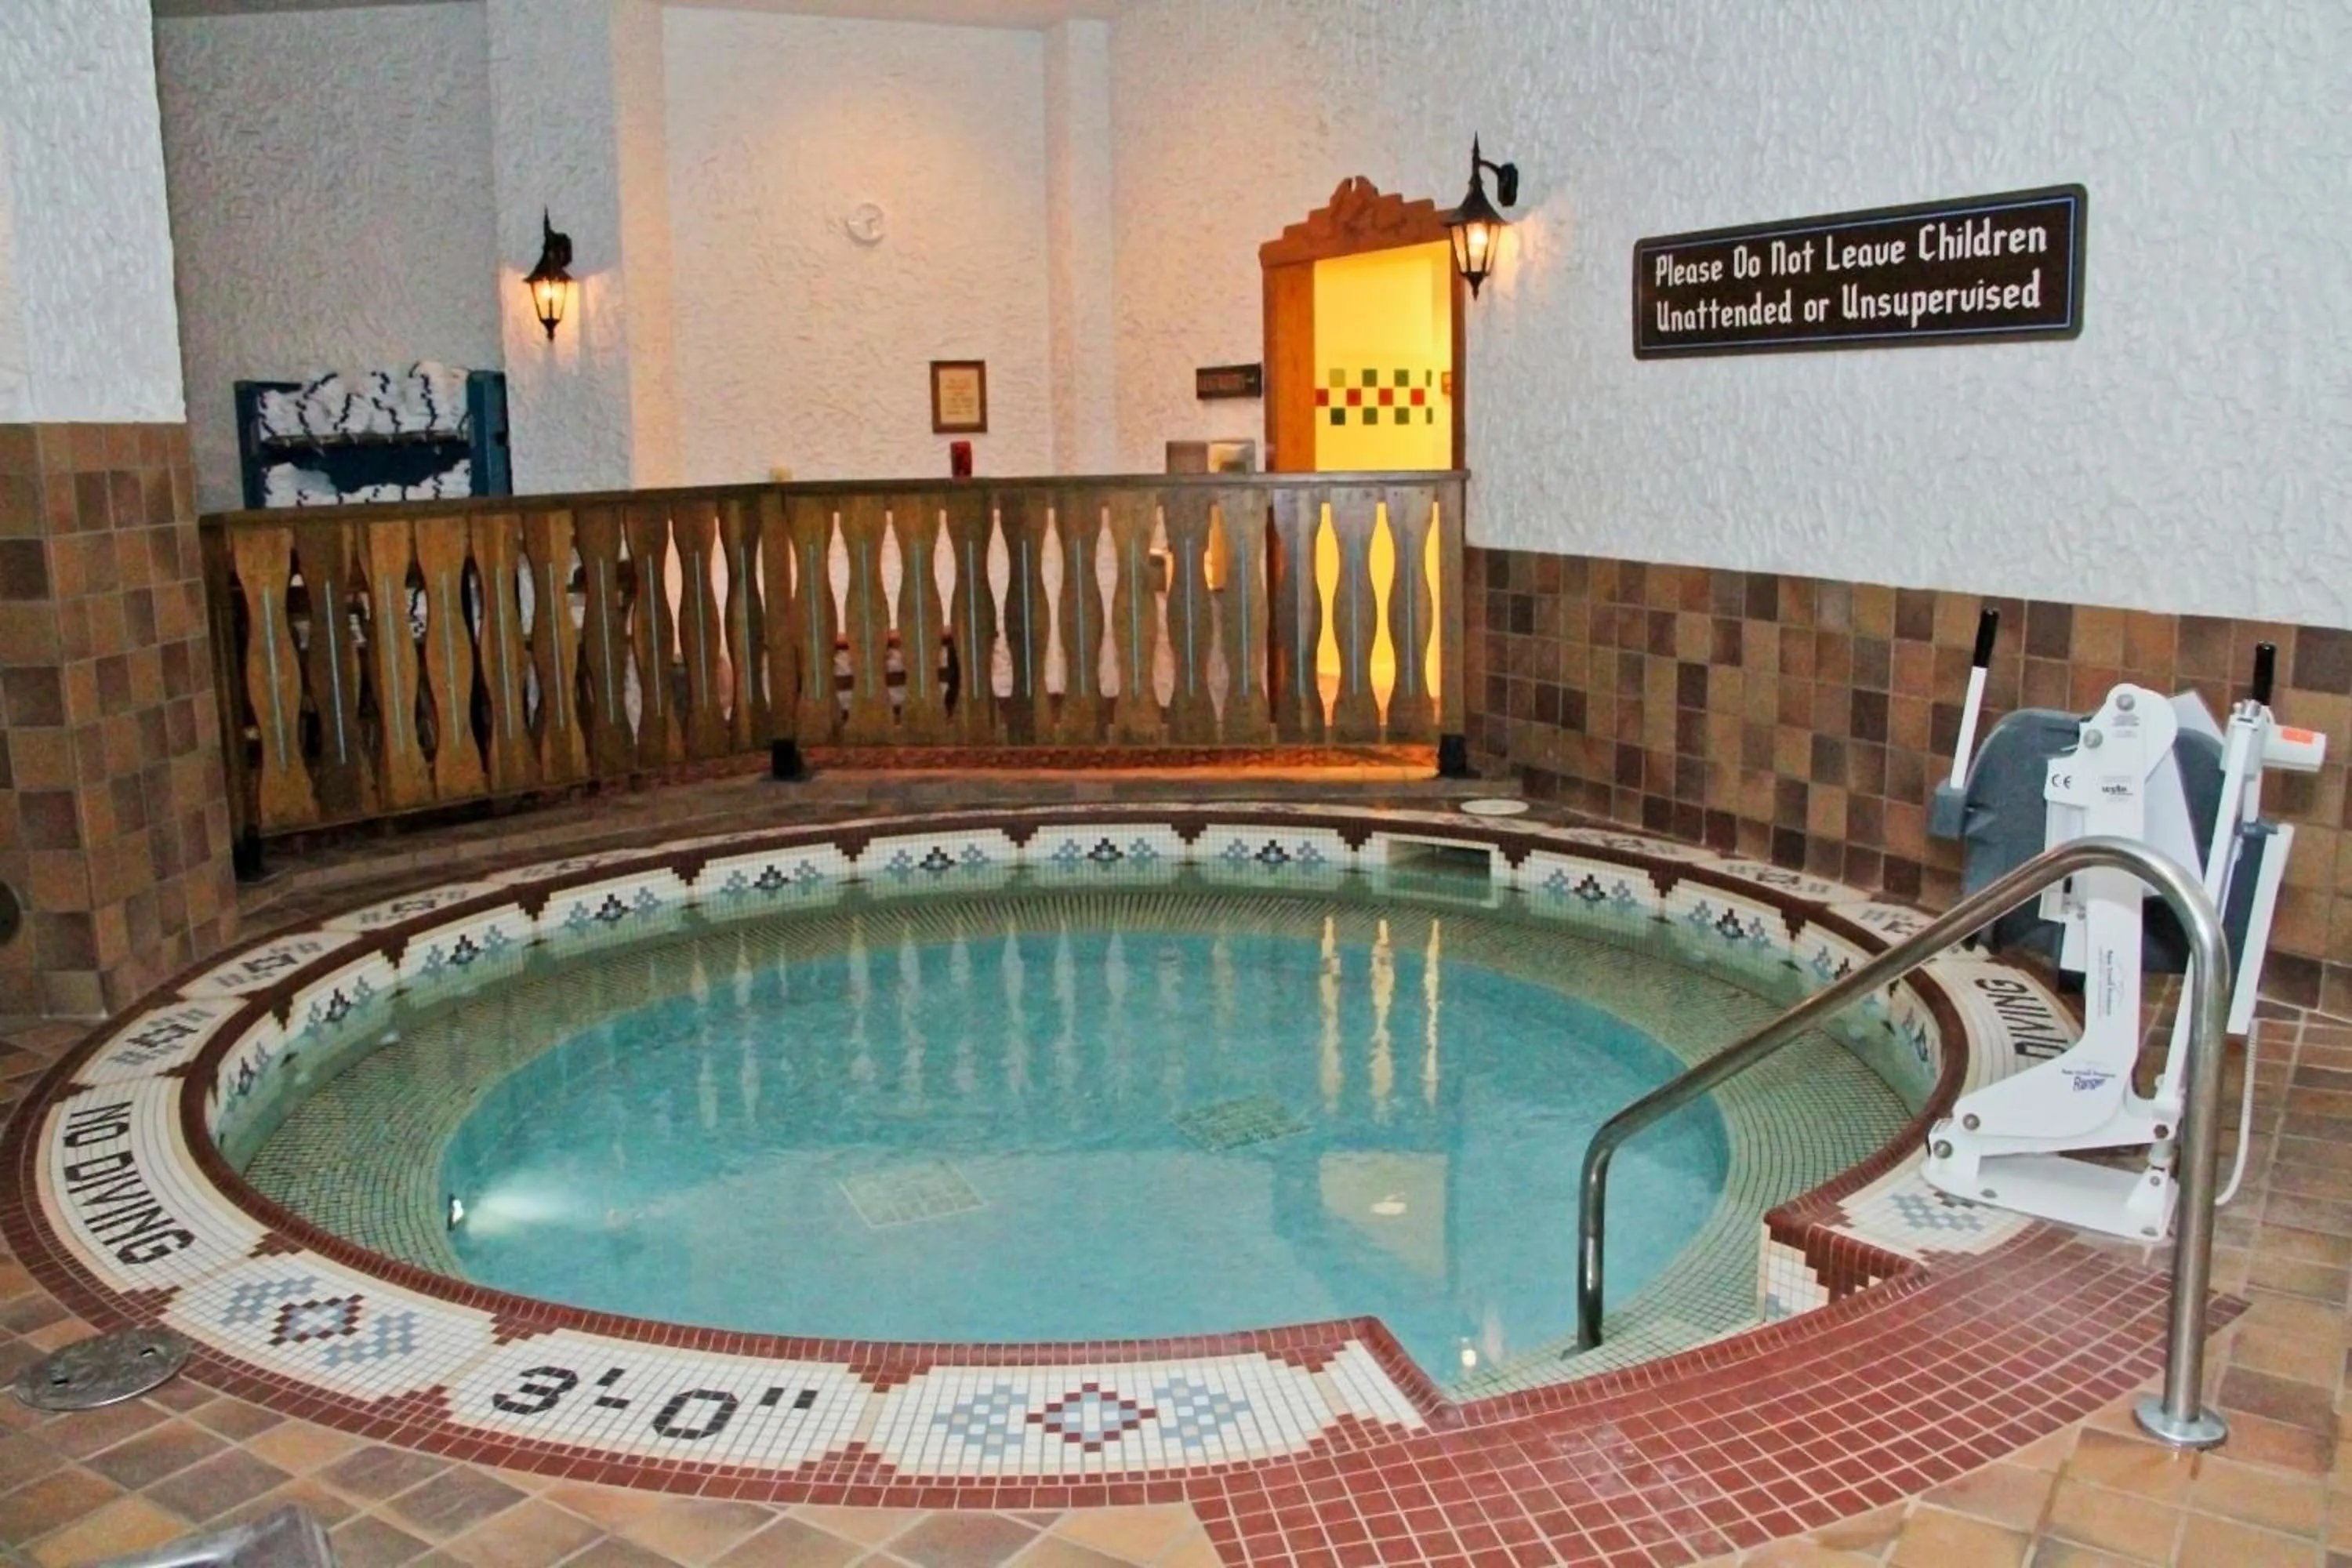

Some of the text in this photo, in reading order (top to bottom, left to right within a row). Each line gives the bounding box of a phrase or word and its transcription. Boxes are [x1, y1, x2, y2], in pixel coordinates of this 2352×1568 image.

[1655, 216, 2047, 287] Please Do Not Leave Children
[1656, 267, 2041, 332] Unattended or Unsupervised
[63, 1101, 195, 1265] NO DIVING
